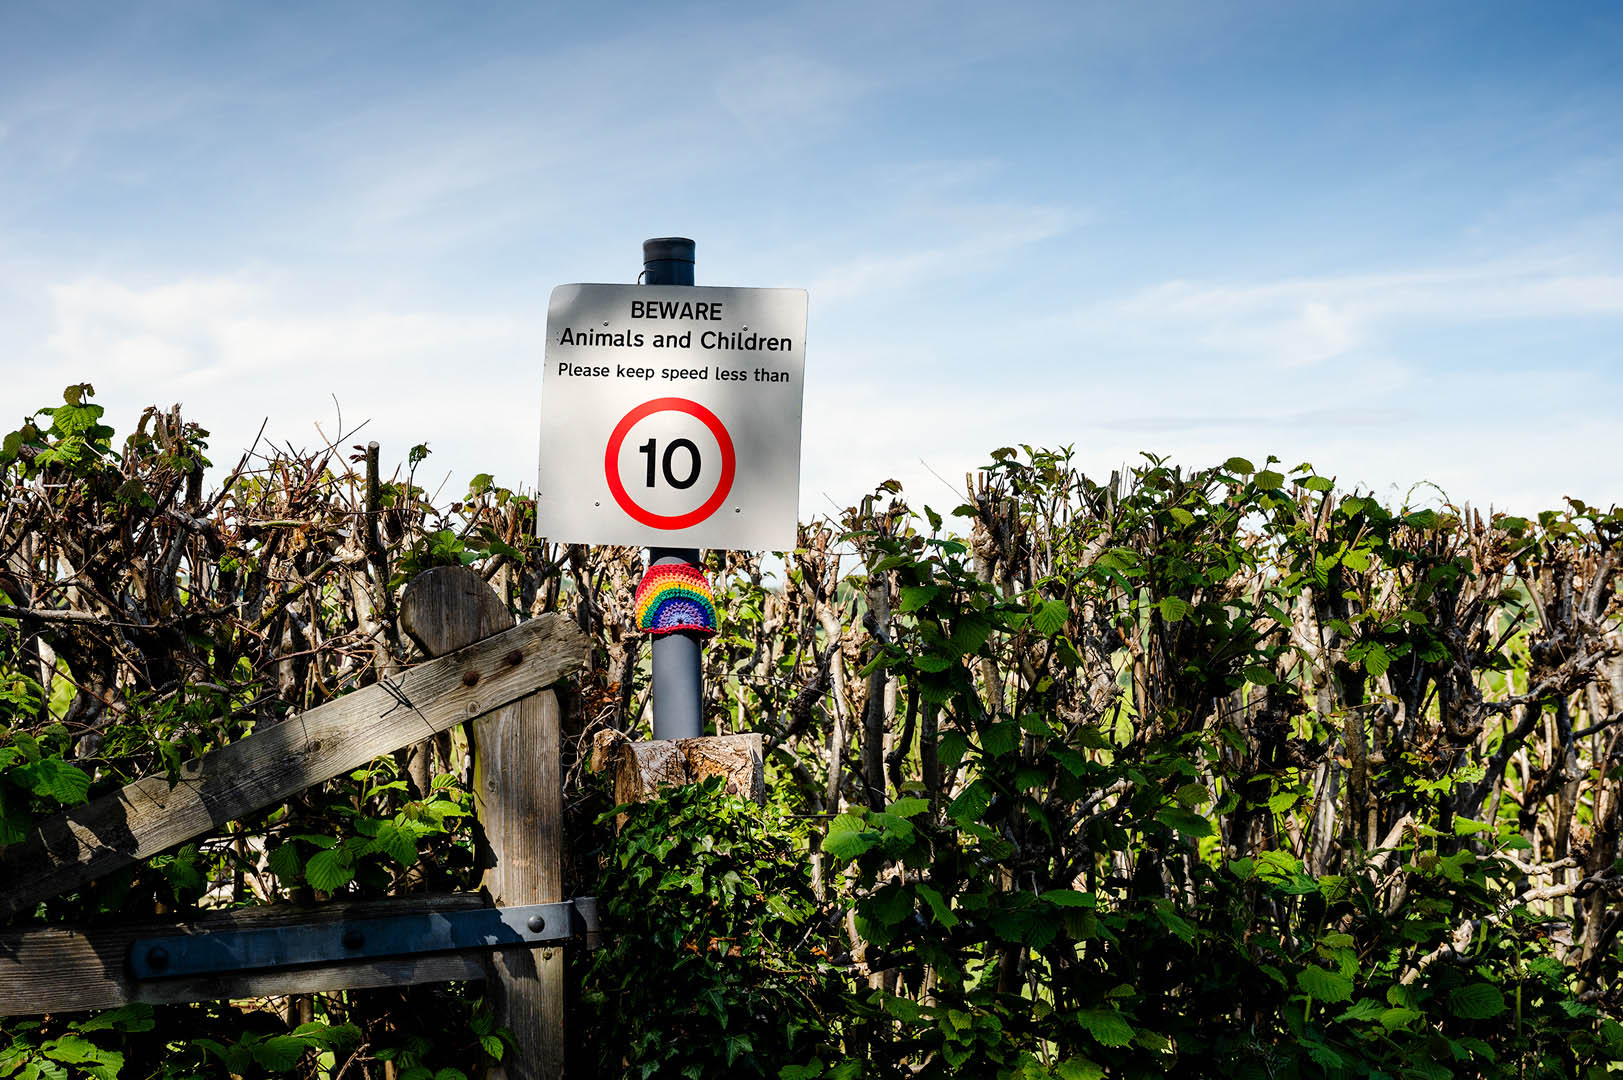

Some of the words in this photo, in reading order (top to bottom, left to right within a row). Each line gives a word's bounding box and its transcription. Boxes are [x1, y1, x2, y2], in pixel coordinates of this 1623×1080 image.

[631, 301, 723, 321] BEWARE
[559, 327, 644, 348] Animals
[652, 331, 691, 349] and
[700, 331, 792, 352] Children
[558, 362, 610, 377] Please
[616, 364, 655, 381] keep
[661, 367, 708, 381] speed
[715, 367, 747, 381] less
[754, 368, 789, 383] than
[639, 437, 702, 490] 10
